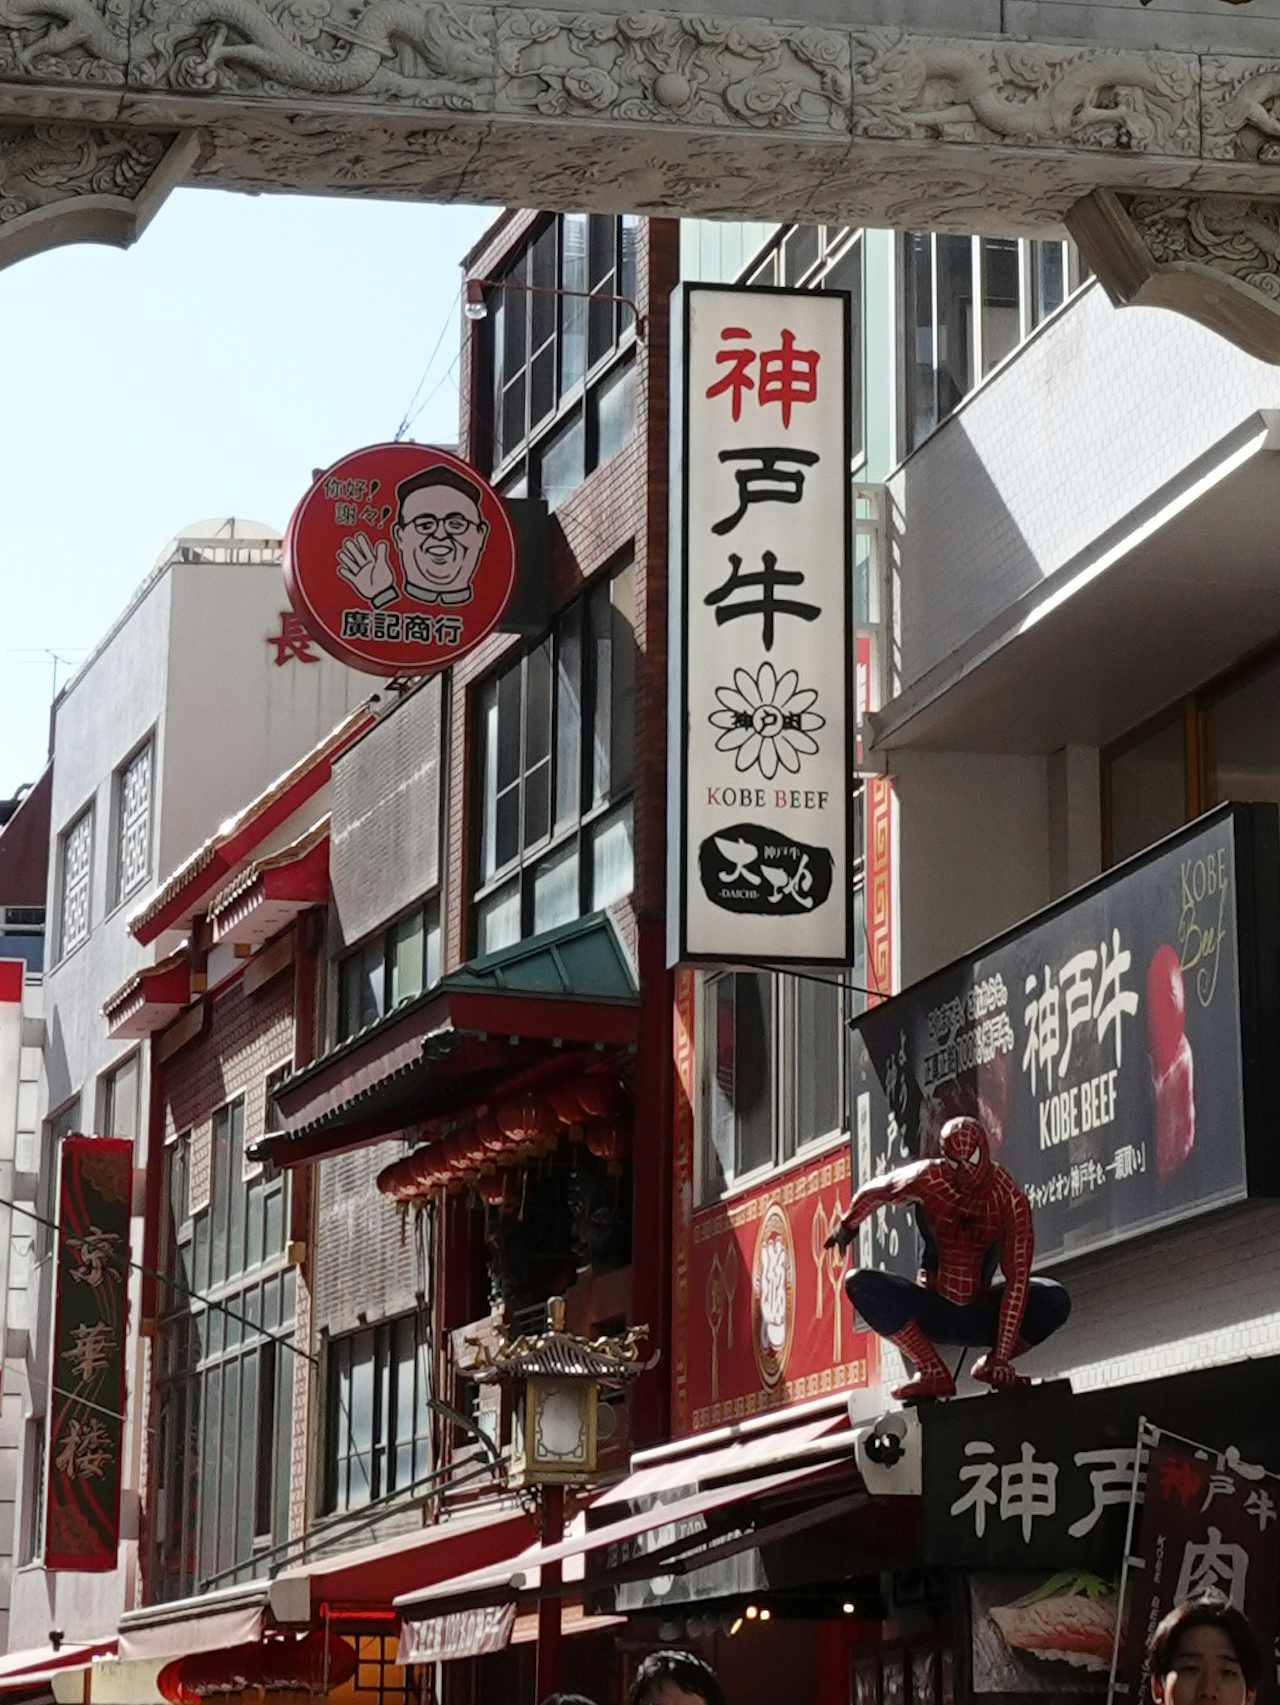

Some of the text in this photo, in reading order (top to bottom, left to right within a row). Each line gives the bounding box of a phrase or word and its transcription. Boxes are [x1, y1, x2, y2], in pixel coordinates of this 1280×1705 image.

[703, 325, 822, 653] 神戸牛
[342, 608, 464, 644] 廣記商行
[706, 786, 829, 810] KOBE BEEF
[1022, 927, 1139, 1097] 神戸牛
[1039, 1068, 1118, 1151] KOBE BEEF
